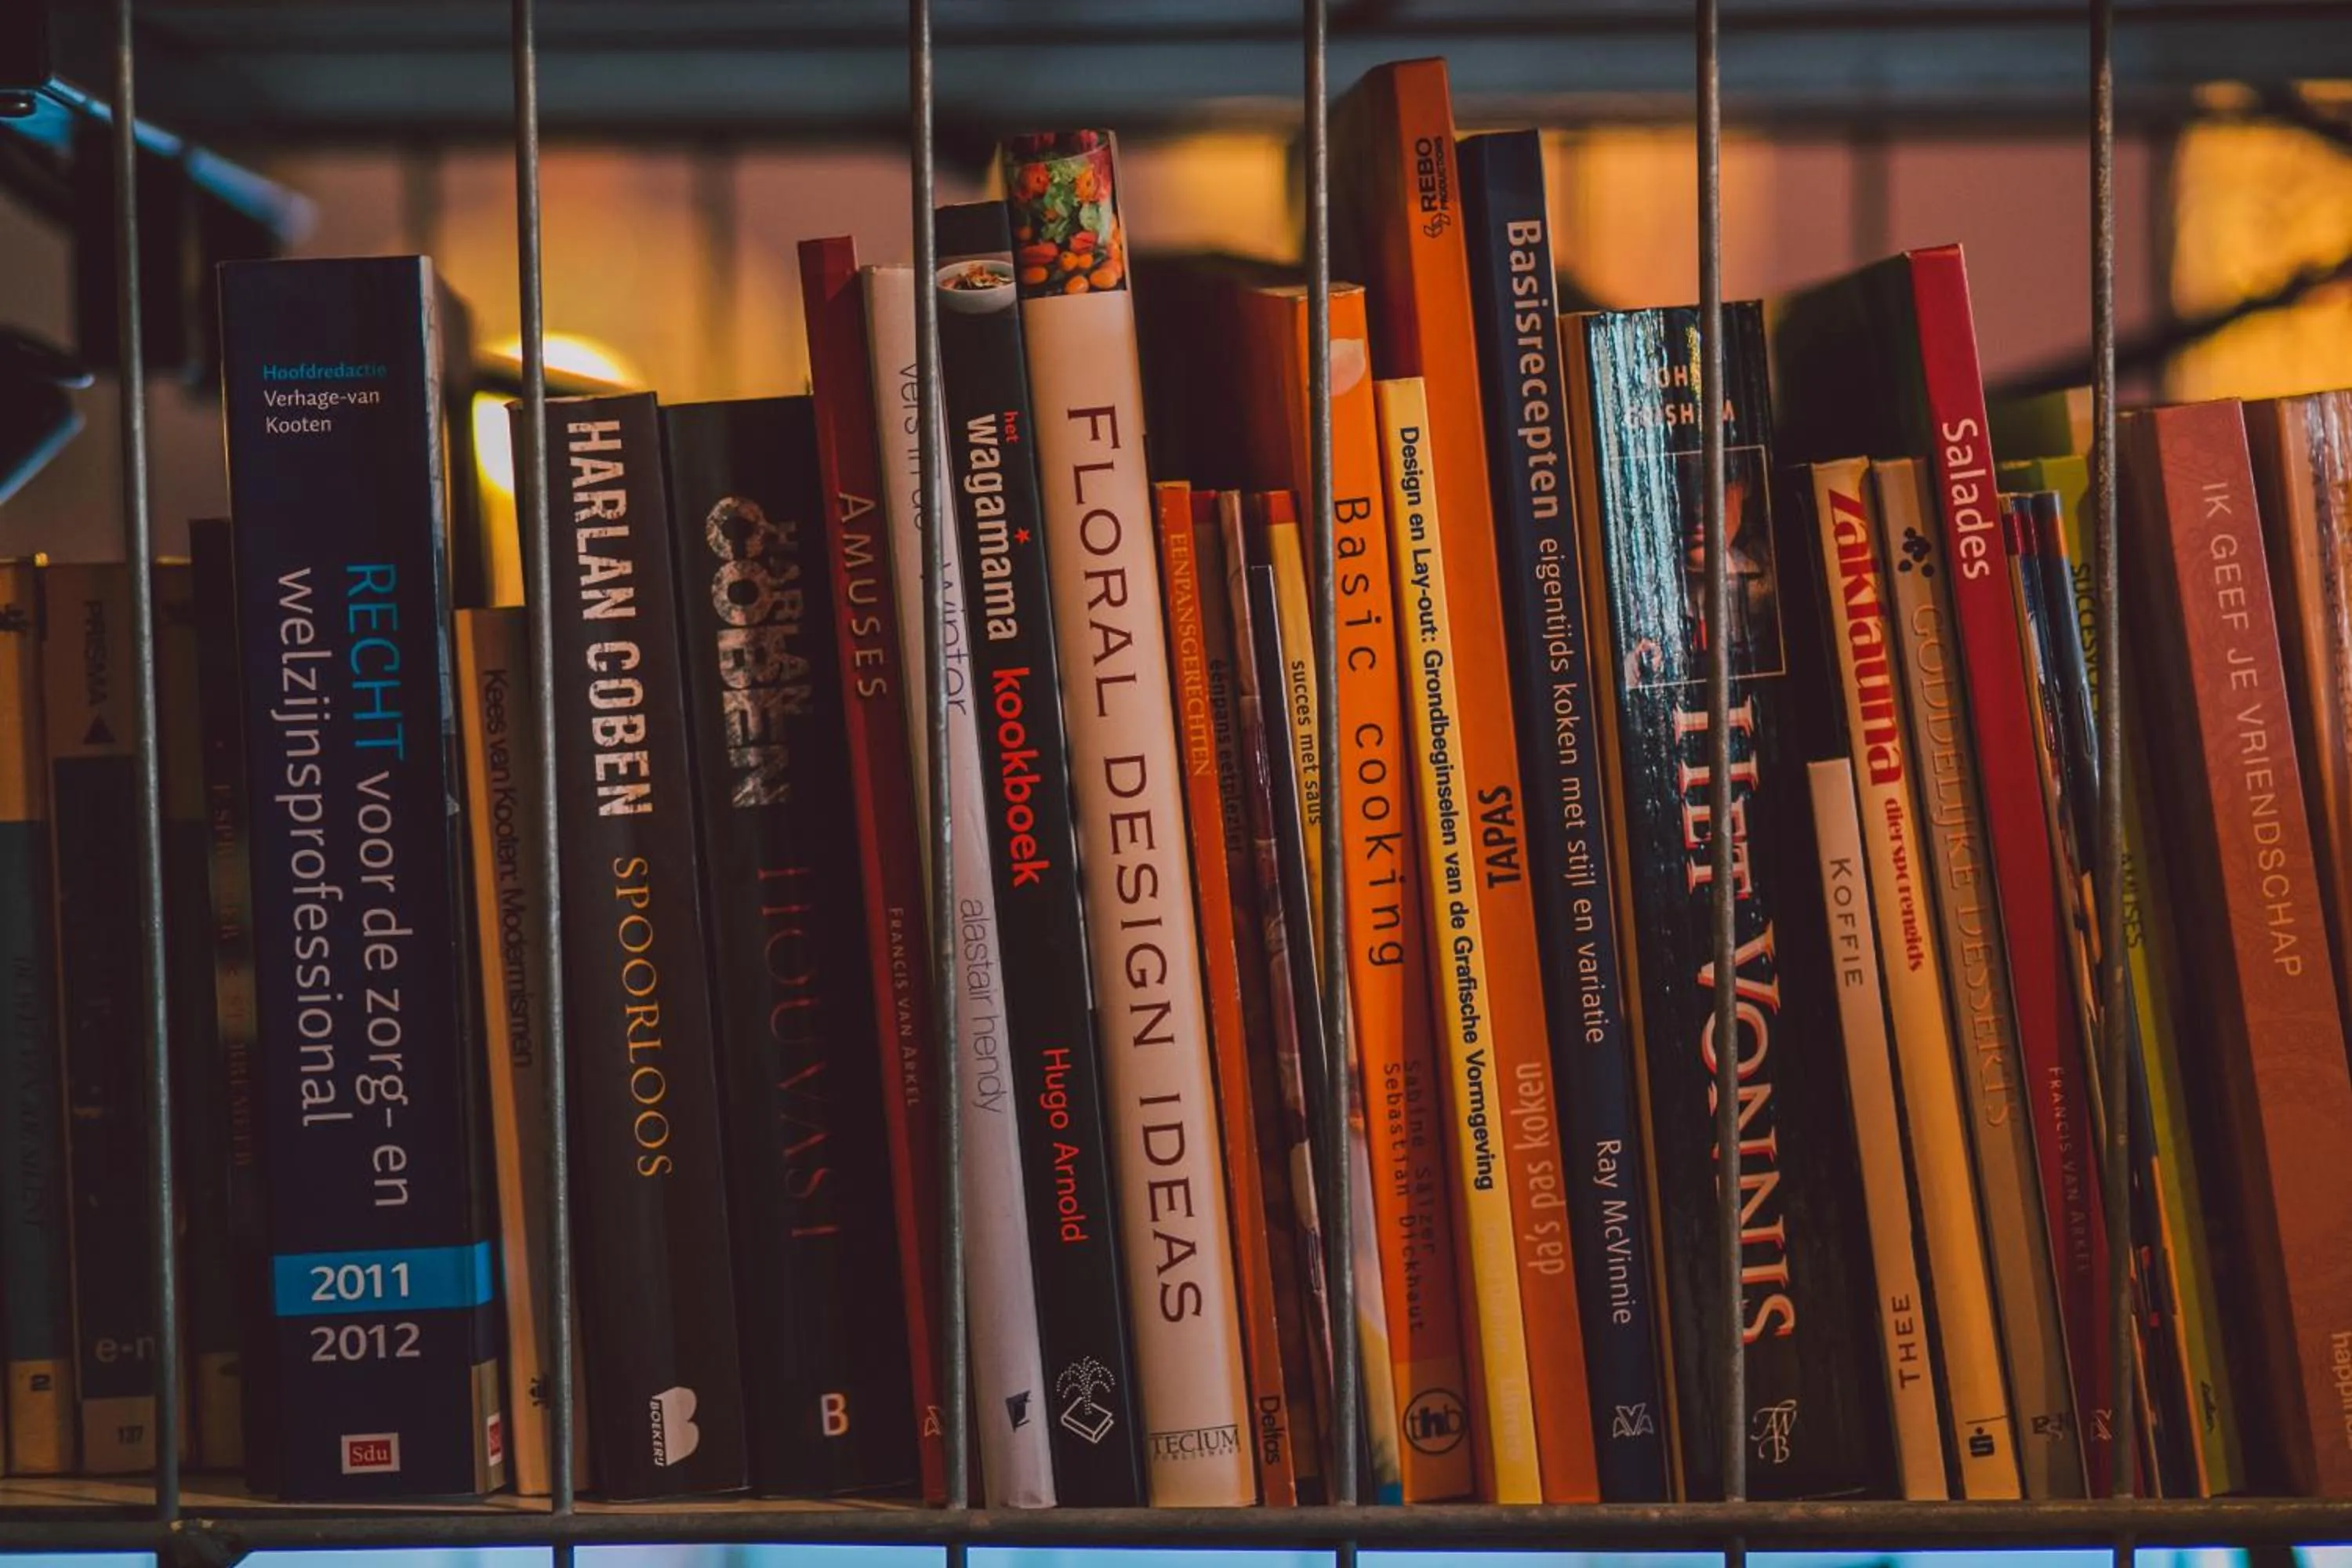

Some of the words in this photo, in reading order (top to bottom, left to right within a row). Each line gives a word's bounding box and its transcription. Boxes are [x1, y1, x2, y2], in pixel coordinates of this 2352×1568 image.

[1416, 138, 1438, 212] REBO
[263, 363, 387, 381] Hoofdredactie
[263, 389, 381, 412] Verhage-van
[1506, 220, 1559, 520] Basisrecepten
[265, 416, 332, 434] Kooten
[1004, 410, 1019, 443] het
[1400, 426, 1422, 506] Design
[566, 419, 637, 620] HARLAN
[963, 413, 1018, 641] wagamama
[1410, 514, 1425, 541] en
[1942, 418, 1994, 579] Salades
[2201, 481, 2233, 519] IK
[838, 491, 887, 699] AMUSES
[1067, 405, 1137, 717] FLORAL
[1333, 495, 1382, 673] Basic
[1411, 548, 1439, 643] Lay-out:
[1537, 538, 1574, 674] eigentijds
[2209, 533, 2250, 633] GEEF
[345, 564, 405, 761] RECHT
[706, 495, 792, 809] COBEN
[1170, 533, 1212, 778] EENPANSGERECHTEN
[1291, 659, 1312, 728] succes
[2227, 647, 2259, 693] JE
[482, 669, 510, 735] Kees
[586, 640, 654, 817] COBEN
[1423, 649, 1458, 847] Grondbeginselen
[1552, 681, 1581, 765] koken
[485, 741, 513, 784] van
[992, 666, 1051, 888] kookboek
[1299, 732, 1319, 775] met
[270, 567, 354, 1128] welzijnsprofessional
[356, 770, 397, 894] voor
[1304, 781, 1323, 827] saus
[1354, 721, 1406, 969] cooking
[1477, 785, 1522, 891] TAPAS
[1562, 776, 1587, 829] met
[2235, 702, 2302, 979] VRIENDSCHAP
[1104, 752, 1175, 1049] DESIGN
[1443, 851, 1461, 895] van
[1563, 838, 1597, 888] stijl
[361, 906, 414, 971] de
[889, 906, 909, 990] FRANCIS
[960, 898, 994, 1006] alastair
[1450, 899, 1469, 930] de
[1573, 898, 1595, 934] en
[1829, 858, 1864, 988] KOFFIE
[500, 888, 533, 1069] Modernismen
[613, 854, 673, 1179] SPOORLOOS
[898, 997, 913, 1037] VAN
[1453, 935, 1482, 1045] Grafische
[1576, 941, 1610, 1046] variatie
[355, 988, 408, 1129] zorg-
[902, 1045, 920, 1108] ARKEL
[971, 1014, 1008, 1114] hendy
[1040, 1046, 1073, 1130] Hugo
[1405, 1059, 1427, 1148] Sabine
[1509, 1061, 1551, 1151] koken
[1464, 1049, 1496, 1191] Vormgeving
[1592, 1138, 1623, 1189] Ray
[2048, 1065, 2073, 1152] FRANCIS
[2061, 1158, 2079, 1202] VAN
[372, 1144, 410, 1207] en
[1052, 1142, 1089, 1245] Arnold
[1138, 1092, 1203, 1324] IDEAS
[1384, 1062, 1411, 1197] Sebastian
[1399, 1214, 1425, 1333] Dickhaut
[1527, 1160, 1566, 1209] pas
[310, 1261, 411, 1301] 2011
[1602, 1200, 1638, 1326] McVinnie
[310, 1322, 422, 1363] 2012
[1892, 1294, 1920, 1390] THEE
[352, 1443, 387, 1464] Sdu
[820, 1392, 849, 1438] B
